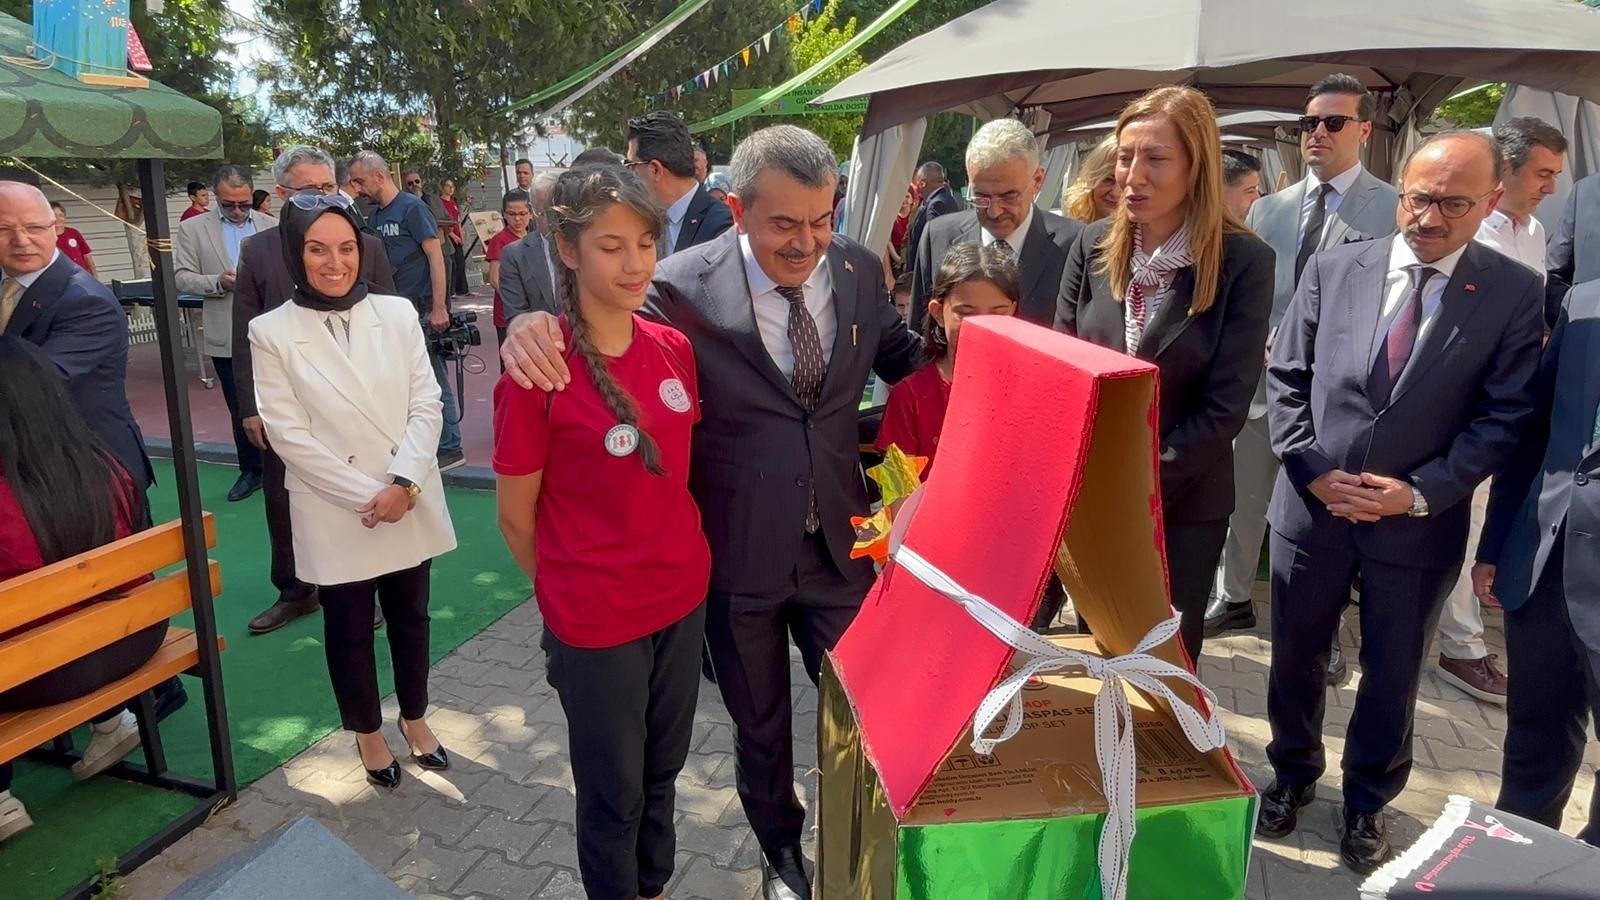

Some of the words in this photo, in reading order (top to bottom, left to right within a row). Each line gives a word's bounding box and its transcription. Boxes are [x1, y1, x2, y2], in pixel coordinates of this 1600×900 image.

[1022, 708, 1073, 720] ASPAS
[1074, 706, 1095, 715] SE
[1021, 721, 1037, 730] OP
[1042, 719, 1067, 728] SET
